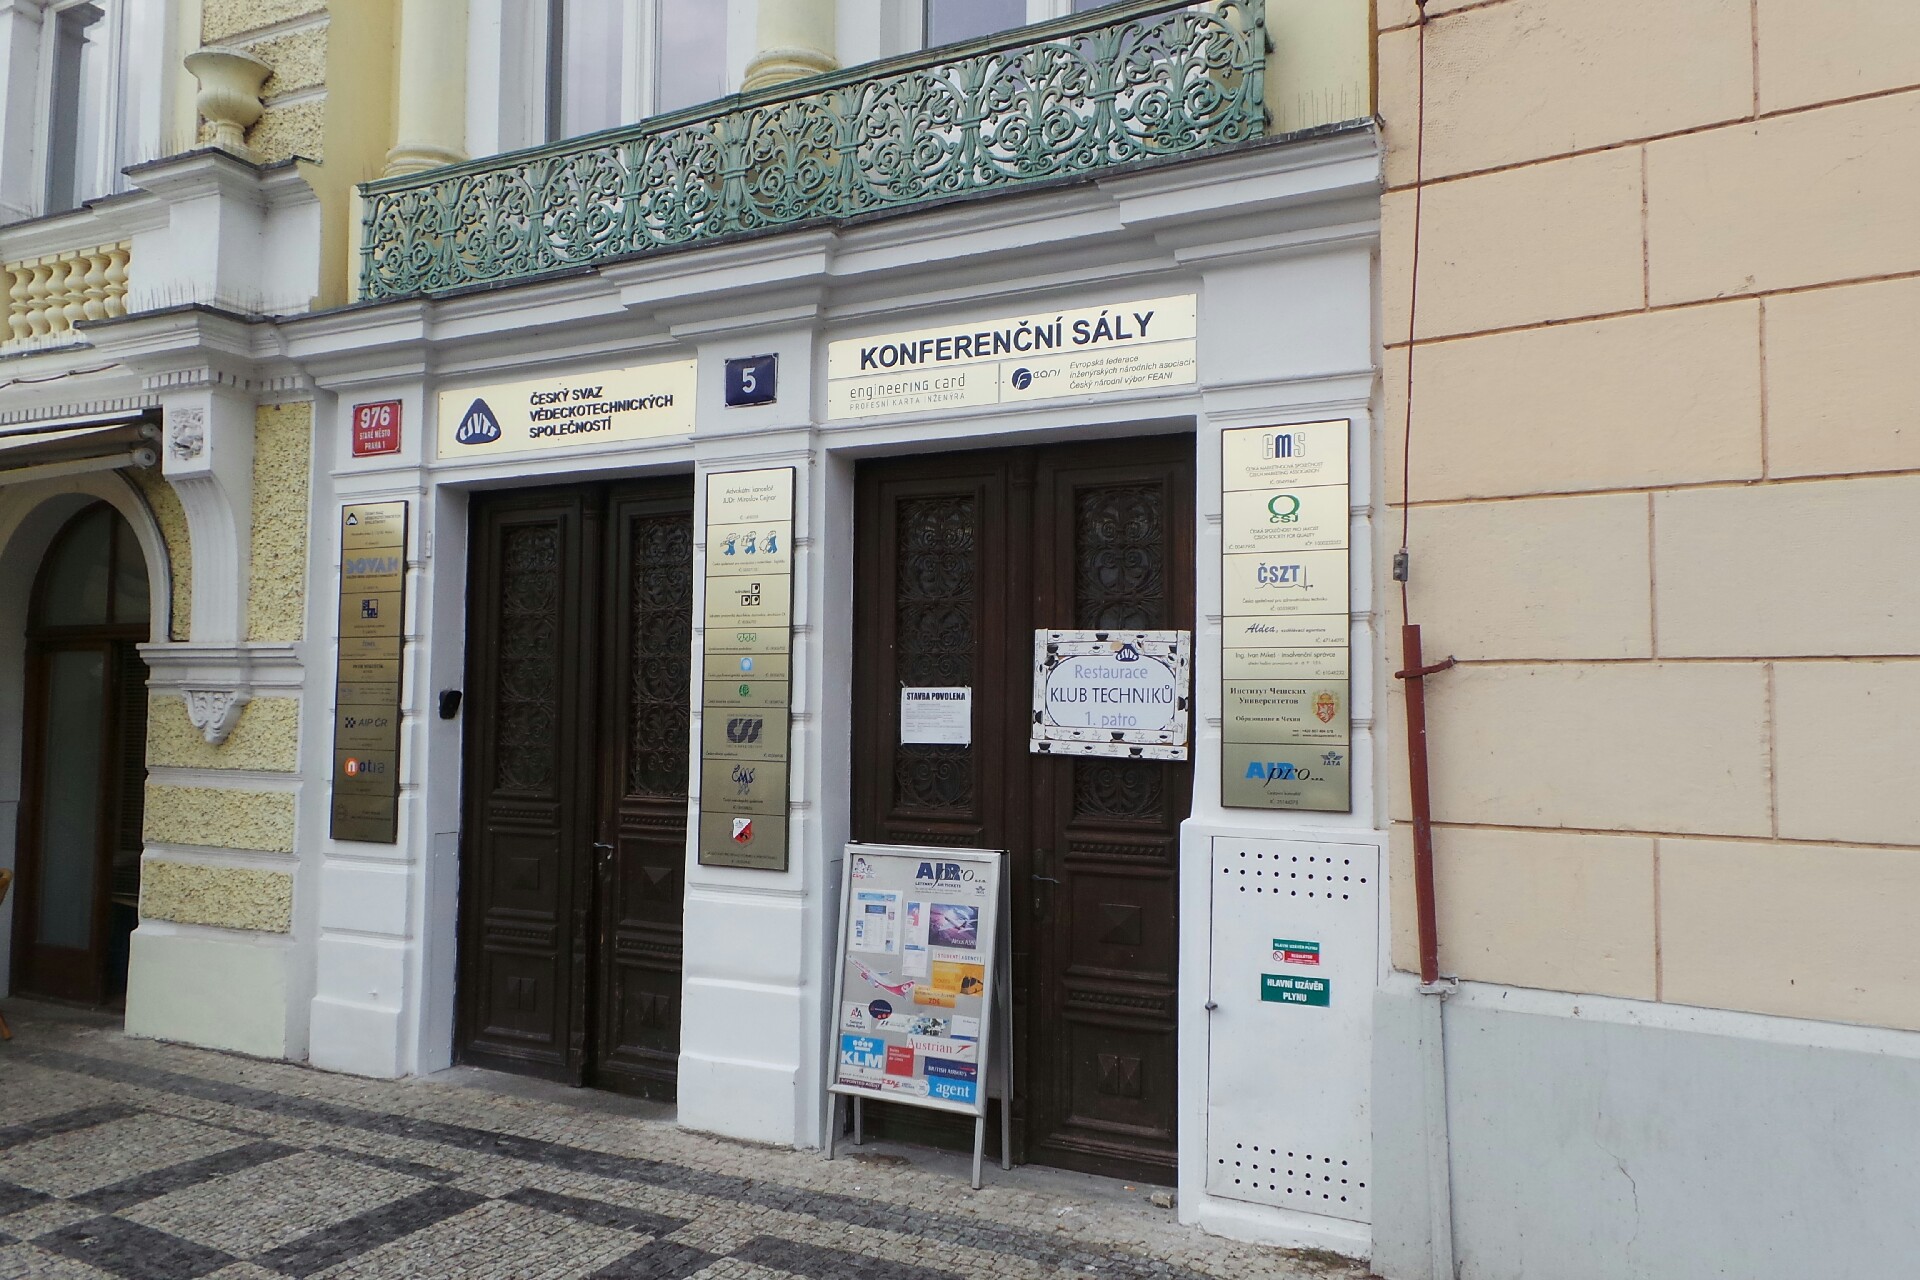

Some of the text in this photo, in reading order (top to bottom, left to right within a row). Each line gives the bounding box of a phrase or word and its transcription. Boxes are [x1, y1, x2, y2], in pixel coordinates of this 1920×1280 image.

[860, 310, 1155, 371] KONFERENČNÍ SÁLY
[1070, 355, 1139, 369] Evropská federace
[1070, 366, 1118, 379] inženýrských
[1120, 363, 1157, 374] národních
[742, 367, 756, 393] 5
[935, 373, 966, 389] card
[1070, 372, 1173, 390] Český národní výbor FEANI
[530, 386, 603, 406] ČESKÝ SVAZ
[849, 392, 966, 411] PROFESNÍ KARTA INŽENÝRA
[361, 405, 390, 428] 976
[530, 394, 673, 422] VĚDECKOTECHNICKÝCH
[529, 416, 611, 439] SPOLEČNOSTÍ
[1262, 432, 1306, 460] CMS
[1257, 562, 1300, 583] ČSZT
[1074, 665, 1148, 679] Restaurace
[906, 691, 966, 701] STAVBA POVOLENA
[1050, 684, 1174, 704] KLUB TECHNIKŮ
[1269, 687, 1307, 695] Чешских
[1084, 711, 1137, 729] 1. patro
[1267, 978, 1324, 991] HLAVNÍ UZÁVĚR
[1283, 992, 1307, 1002] PLYNU
[906, 1037, 953, 1055] Austrian
[841, 1050, 884, 1069] KLM
[935, 1082, 970, 1098] agent
